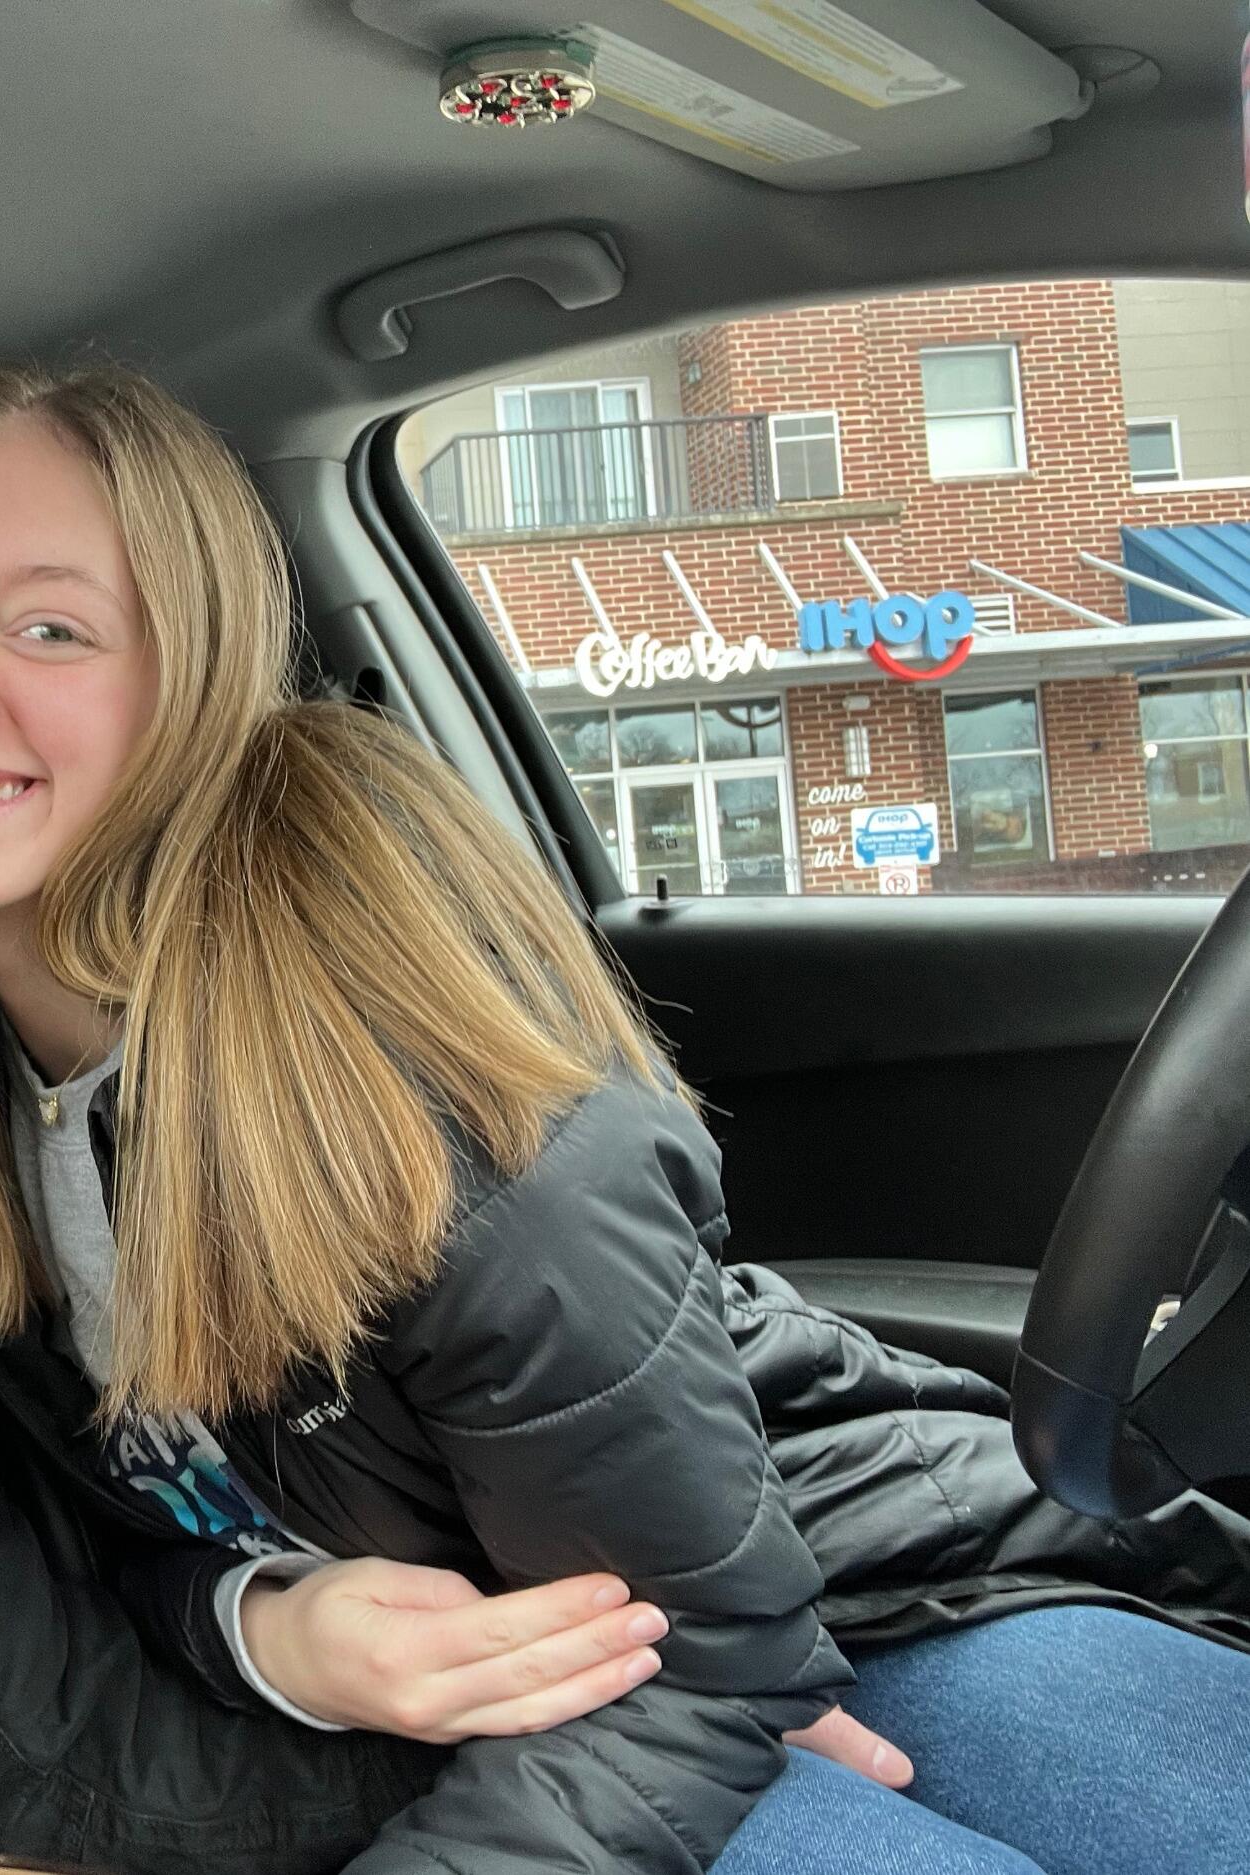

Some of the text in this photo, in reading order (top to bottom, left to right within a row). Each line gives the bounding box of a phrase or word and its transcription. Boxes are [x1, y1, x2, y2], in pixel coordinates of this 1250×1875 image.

[800, 591, 975, 661] IHOP
[574, 631, 778, 697] Coffee Bar
[808, 783, 867, 805] come
[811, 817, 841, 837] on
[814, 842, 846, 868] in!
